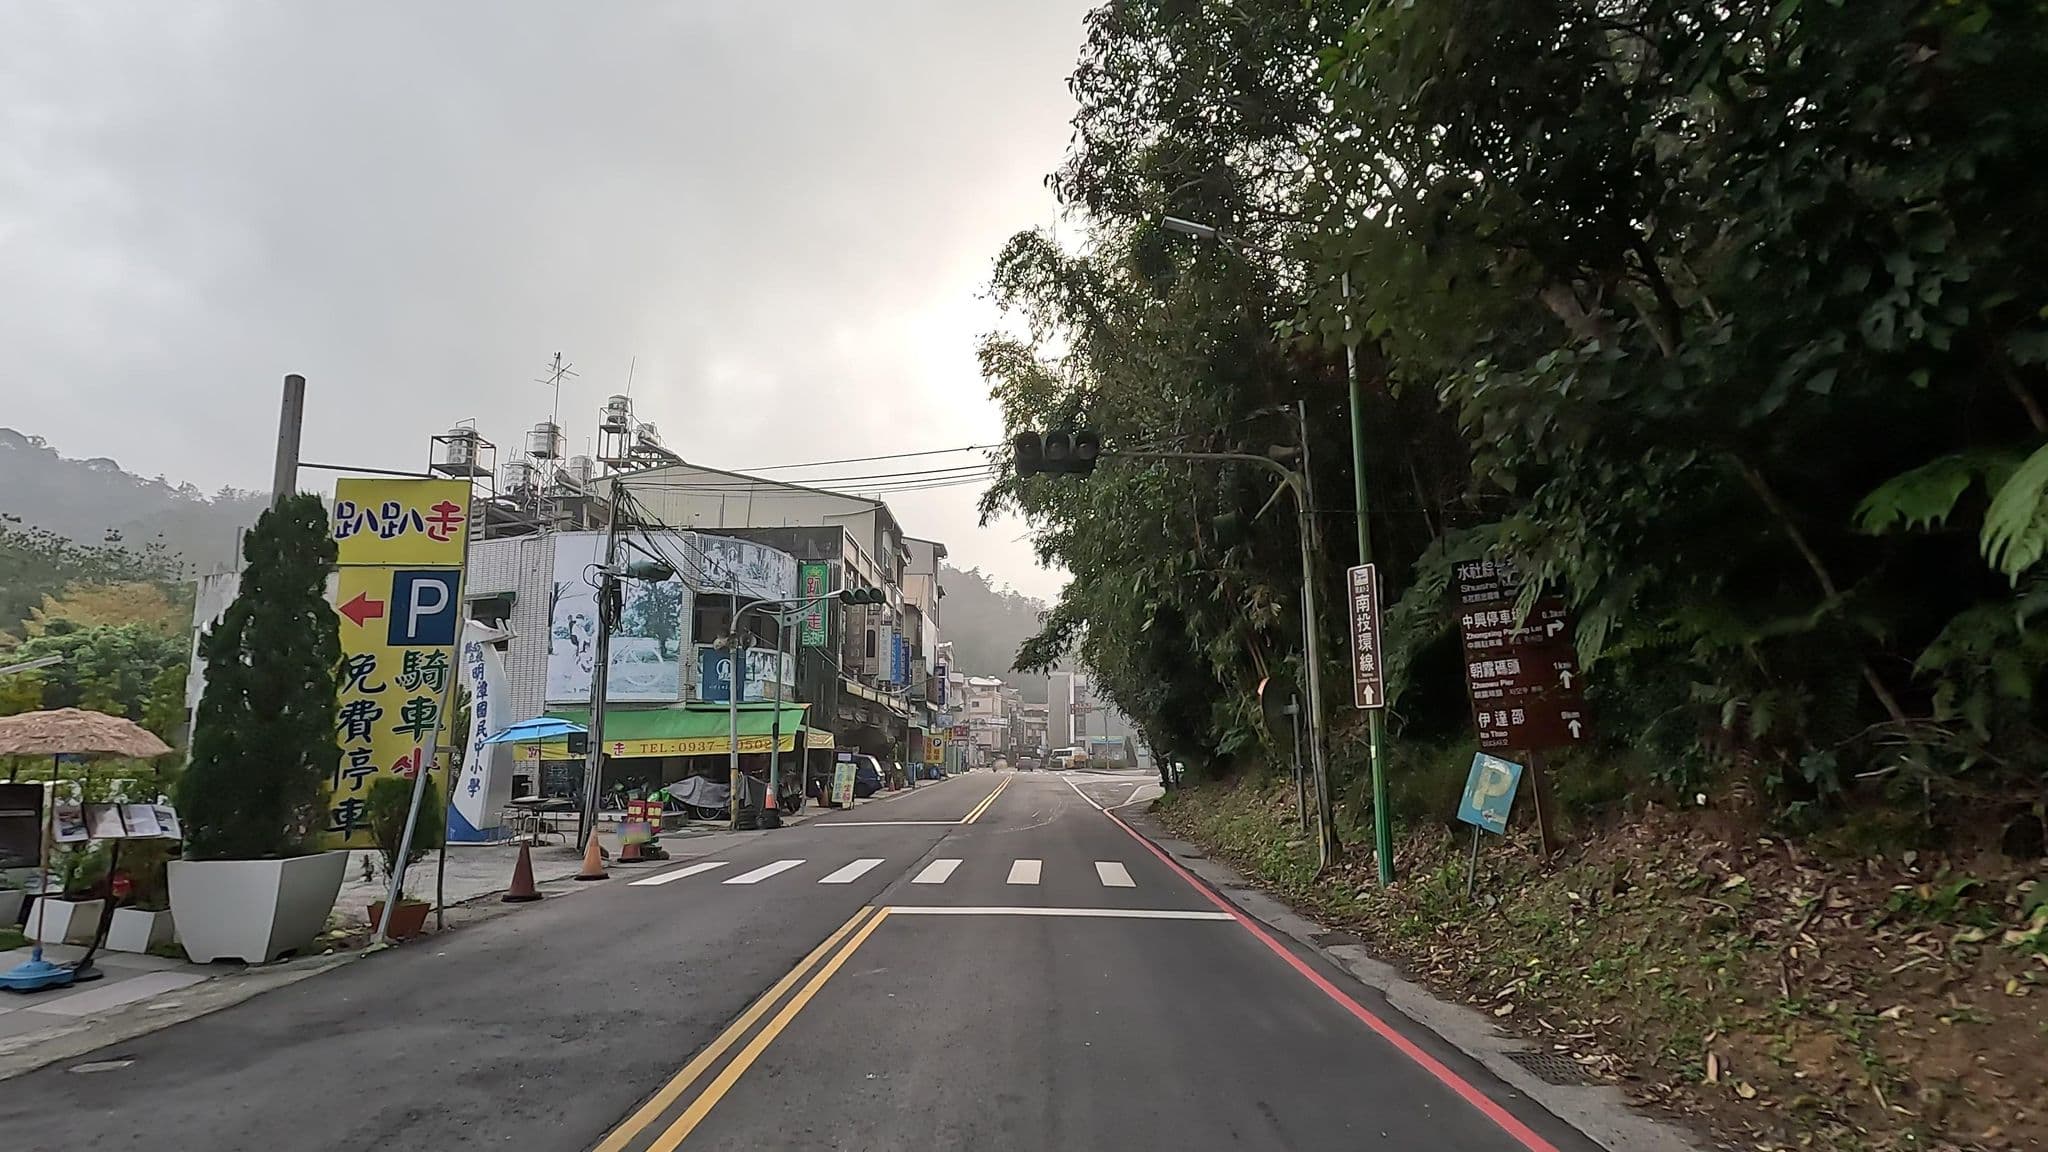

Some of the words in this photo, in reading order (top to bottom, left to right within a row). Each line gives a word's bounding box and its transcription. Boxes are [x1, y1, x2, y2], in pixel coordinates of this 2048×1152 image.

[335, 501, 465, 541] 趴趴走
[407, 579, 449, 638] P
[1355, 594, 1374, 672] 南投環線
[326, 653, 388, 842] 免費停車
